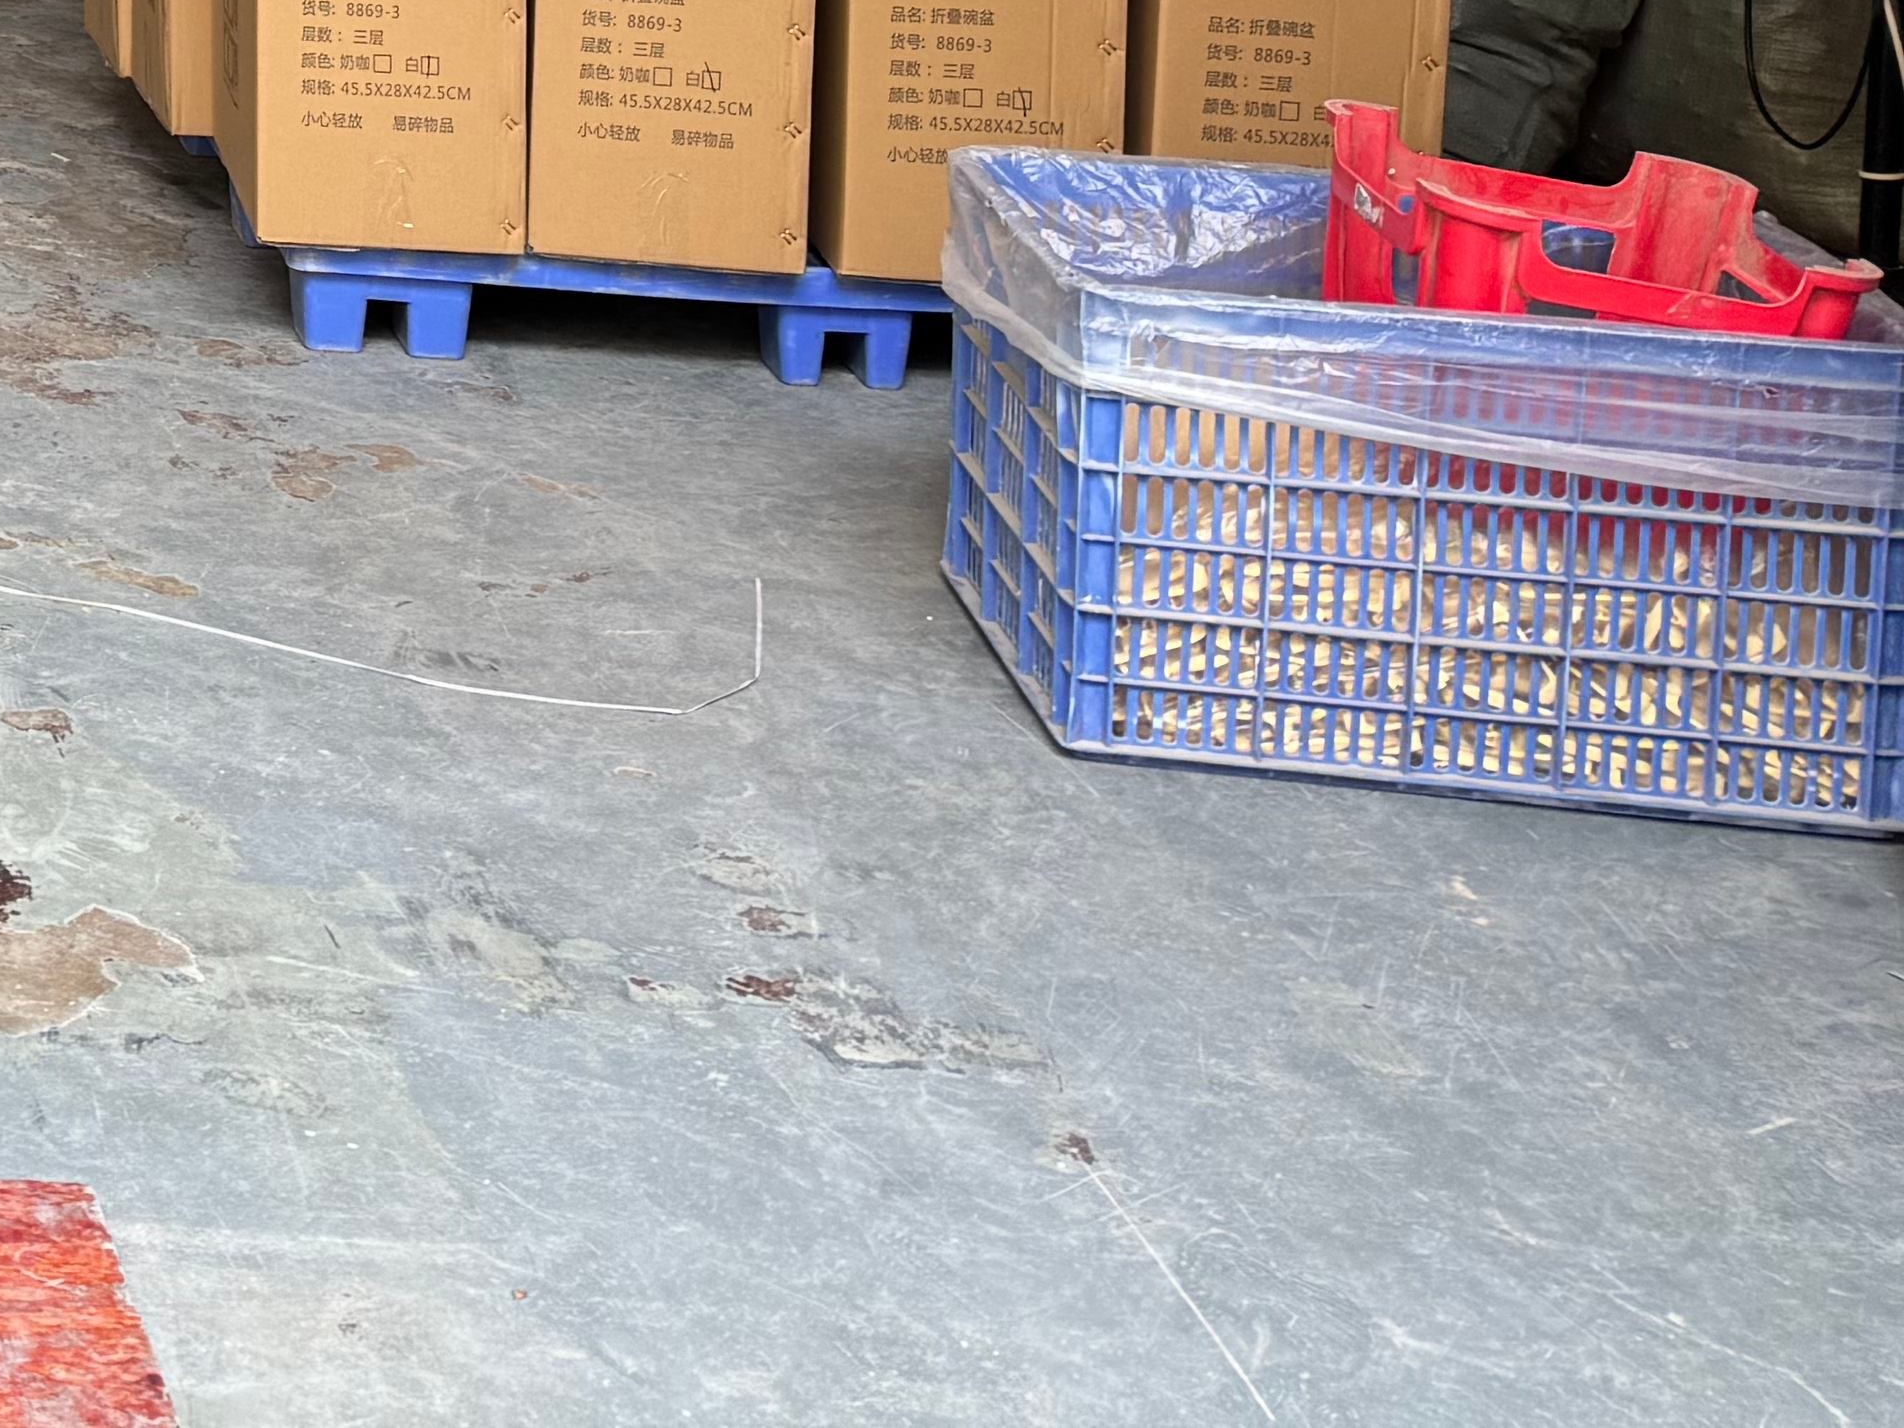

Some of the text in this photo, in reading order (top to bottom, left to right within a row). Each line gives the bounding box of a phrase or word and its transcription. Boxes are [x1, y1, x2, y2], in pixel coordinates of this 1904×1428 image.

[346, 2, 399, 19] 8869-3
[353, 29, 383, 45] 三层
[339, 54, 369, 70] 奶咖
[405, 56, 418, 72] 白
[341, 82, 470, 100] 45.5X28X42.5CM
[301, 111, 453, 133] 小心轻放 易碎物品
